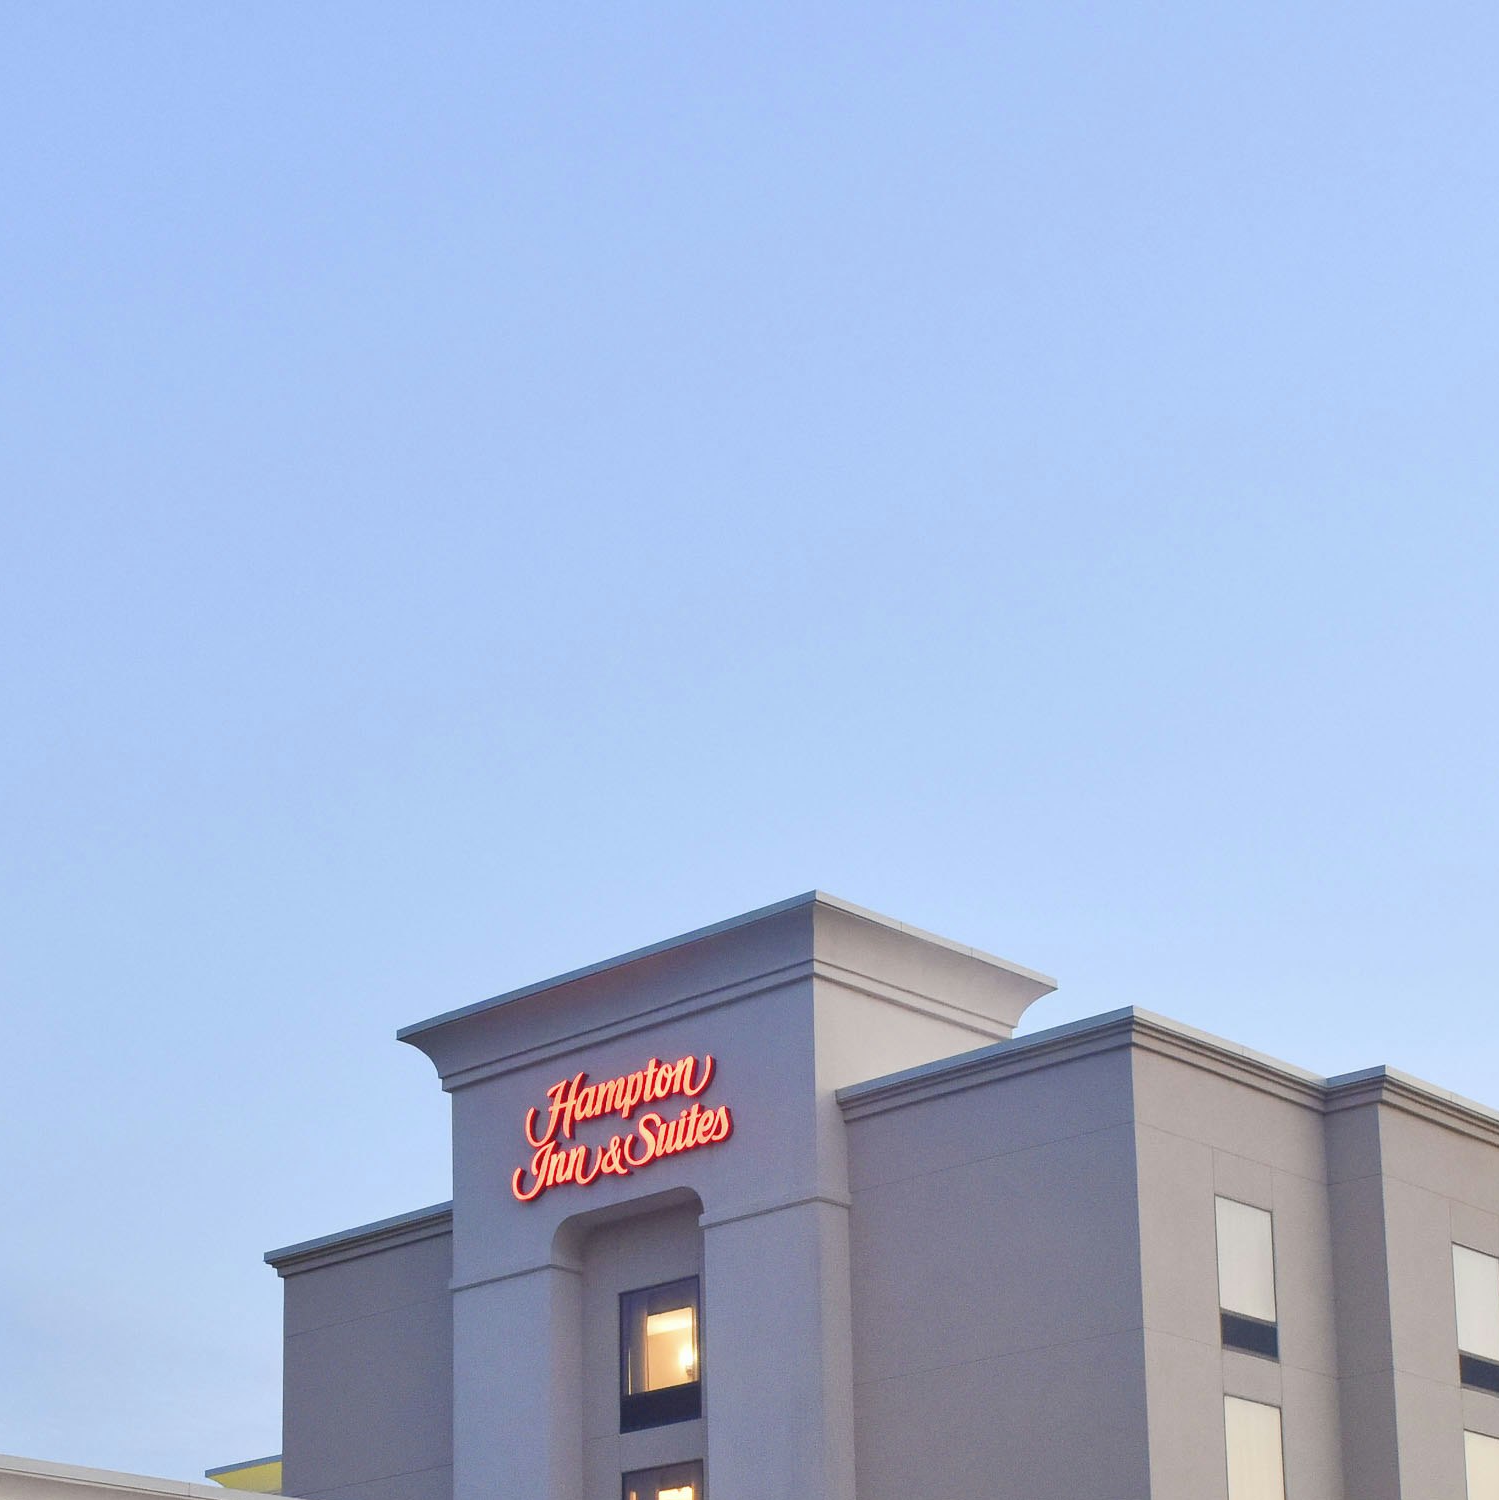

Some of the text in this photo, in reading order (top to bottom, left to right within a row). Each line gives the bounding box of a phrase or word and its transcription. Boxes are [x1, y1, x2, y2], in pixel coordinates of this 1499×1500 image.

[524, 1054, 714, 1148] Hampton
[511, 1102, 732, 1203] Inn & Suites
